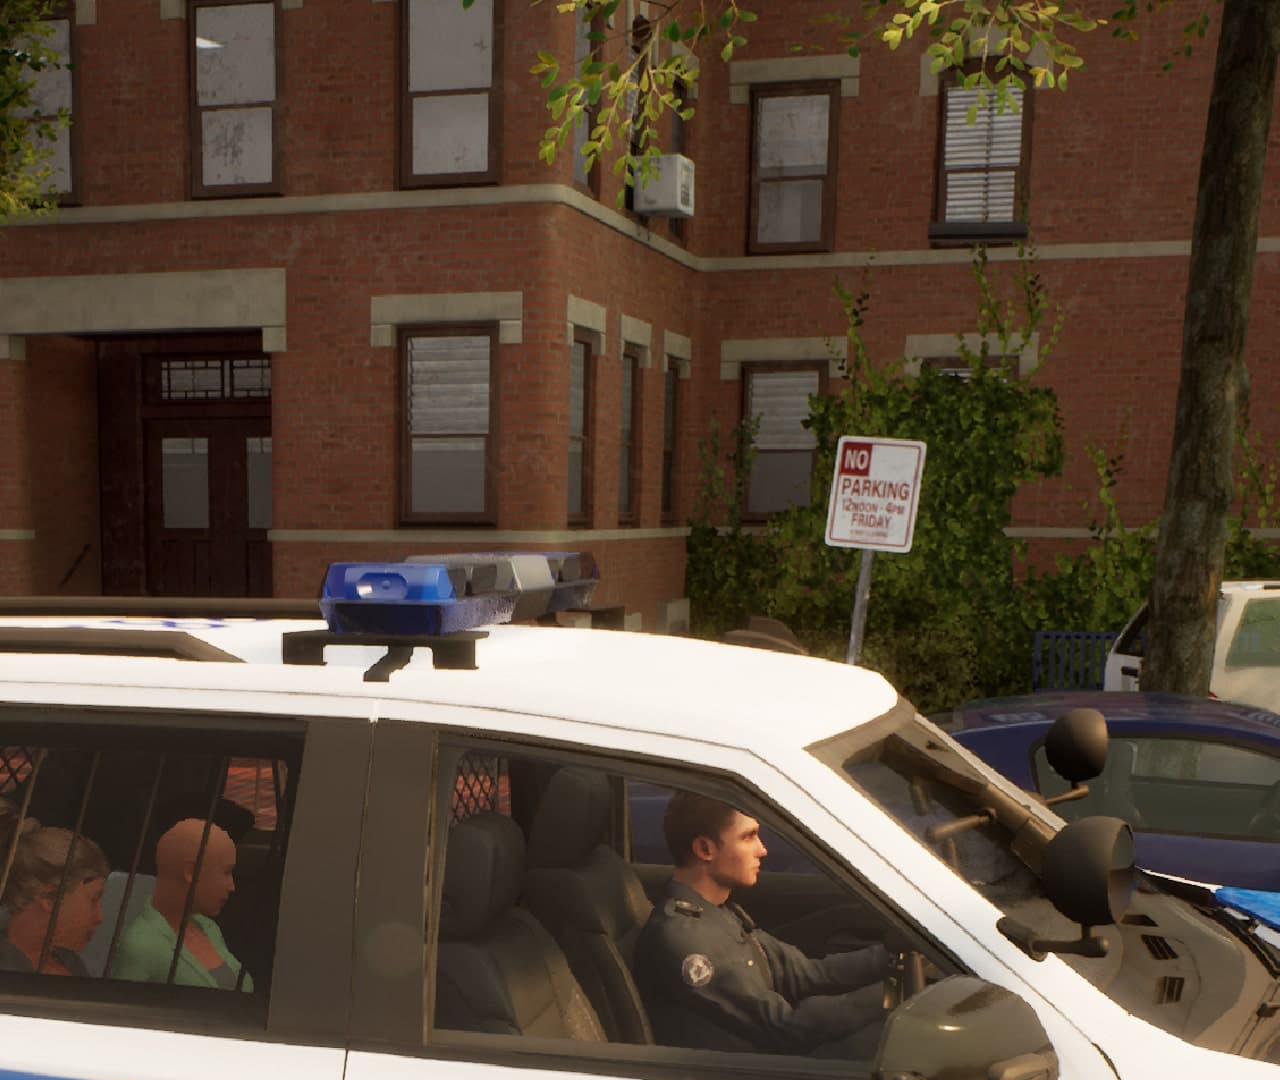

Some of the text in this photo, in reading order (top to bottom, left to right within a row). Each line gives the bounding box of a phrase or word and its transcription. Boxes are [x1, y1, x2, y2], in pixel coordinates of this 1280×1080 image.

[844, 450, 868, 470] NO
[841, 478, 910, 501] PARKING
[850, 513, 891, 528] FRIDAY
